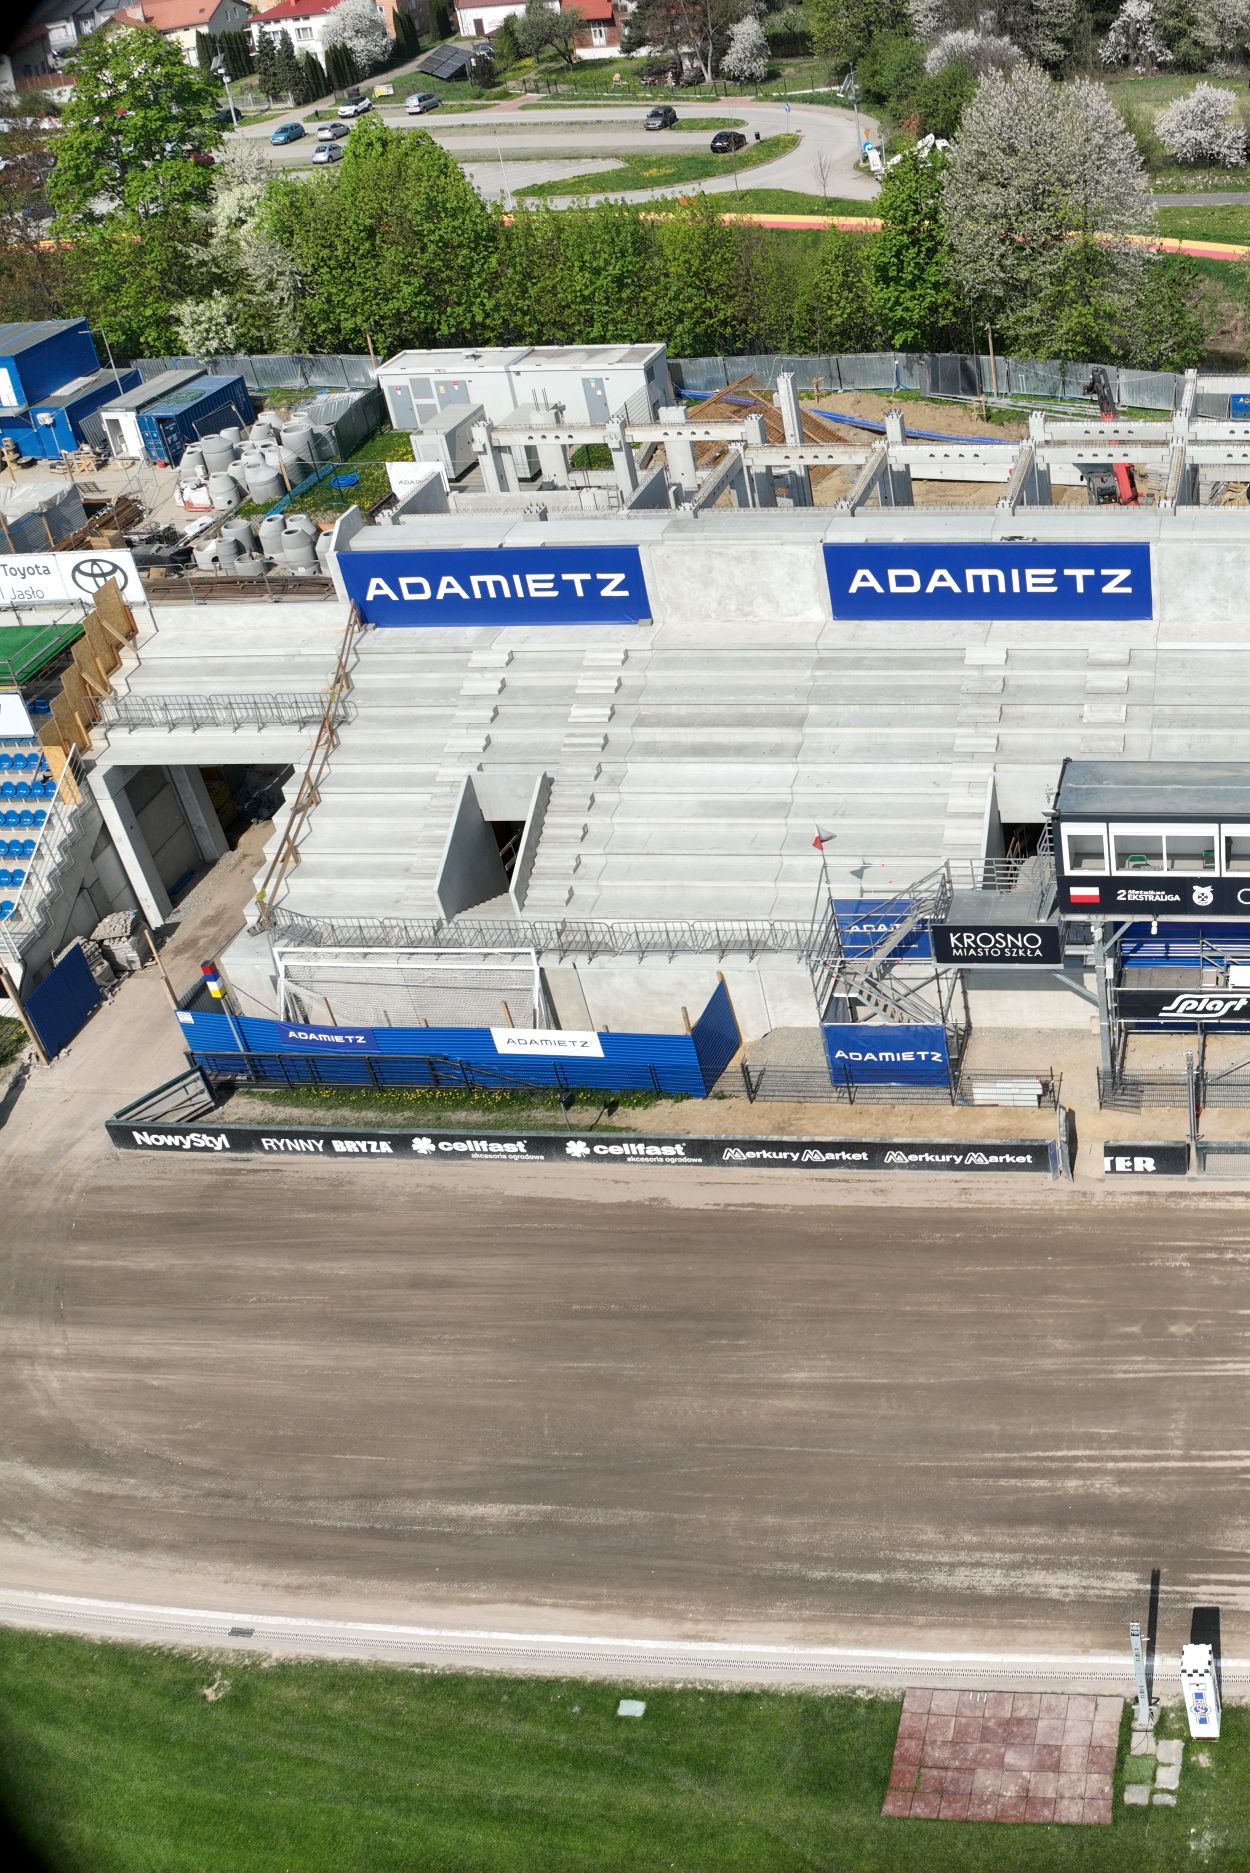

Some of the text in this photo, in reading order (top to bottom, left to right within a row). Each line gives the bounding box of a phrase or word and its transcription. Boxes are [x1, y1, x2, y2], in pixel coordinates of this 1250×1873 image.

[2, 563, 51, 579] Toyota
[365, 573, 630, 601] ADAMIETZ
[848, 567, 1133, 595] ADAMIETZ
[11, 587, 45, 600] Jasło
[1116, 889, 1181, 902] 2 EKSTRALIGA
[949, 933, 1042, 949] KROSNO
[952, 948, 1043, 957] MIASTO SZKŁA
[288, 1031, 367, 1043] ADAMIETZ
[506, 1038, 590, 1048] ADAMIETZ
[835, 1050, 943, 1062] ADAMIETZ
[132, 1131, 231, 1151] NowyStyl
[261, 1138, 394, 1153] RYNNY BRYZA
[438, 1140, 527, 1153] cellfast
[593, 1143, 686, 1156] cellfast
[722, 1148, 869, 1161] Merkury Market
[884, 1151, 1033, 1164] Merkury Market
